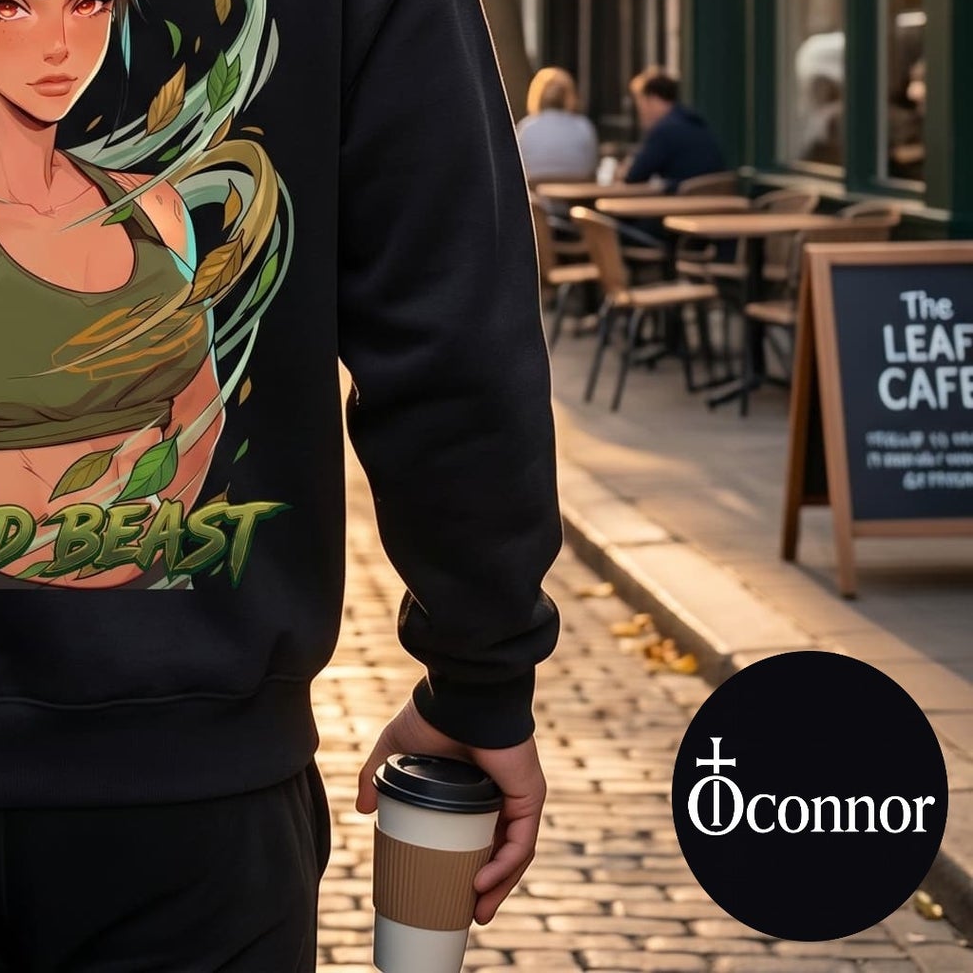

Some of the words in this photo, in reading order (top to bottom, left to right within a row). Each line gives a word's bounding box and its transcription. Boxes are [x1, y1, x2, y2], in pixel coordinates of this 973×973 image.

[899, 290, 955, 321] The
[882, 323, 973, 363] LEAF
[38, 497, 294, 587] BEAST
